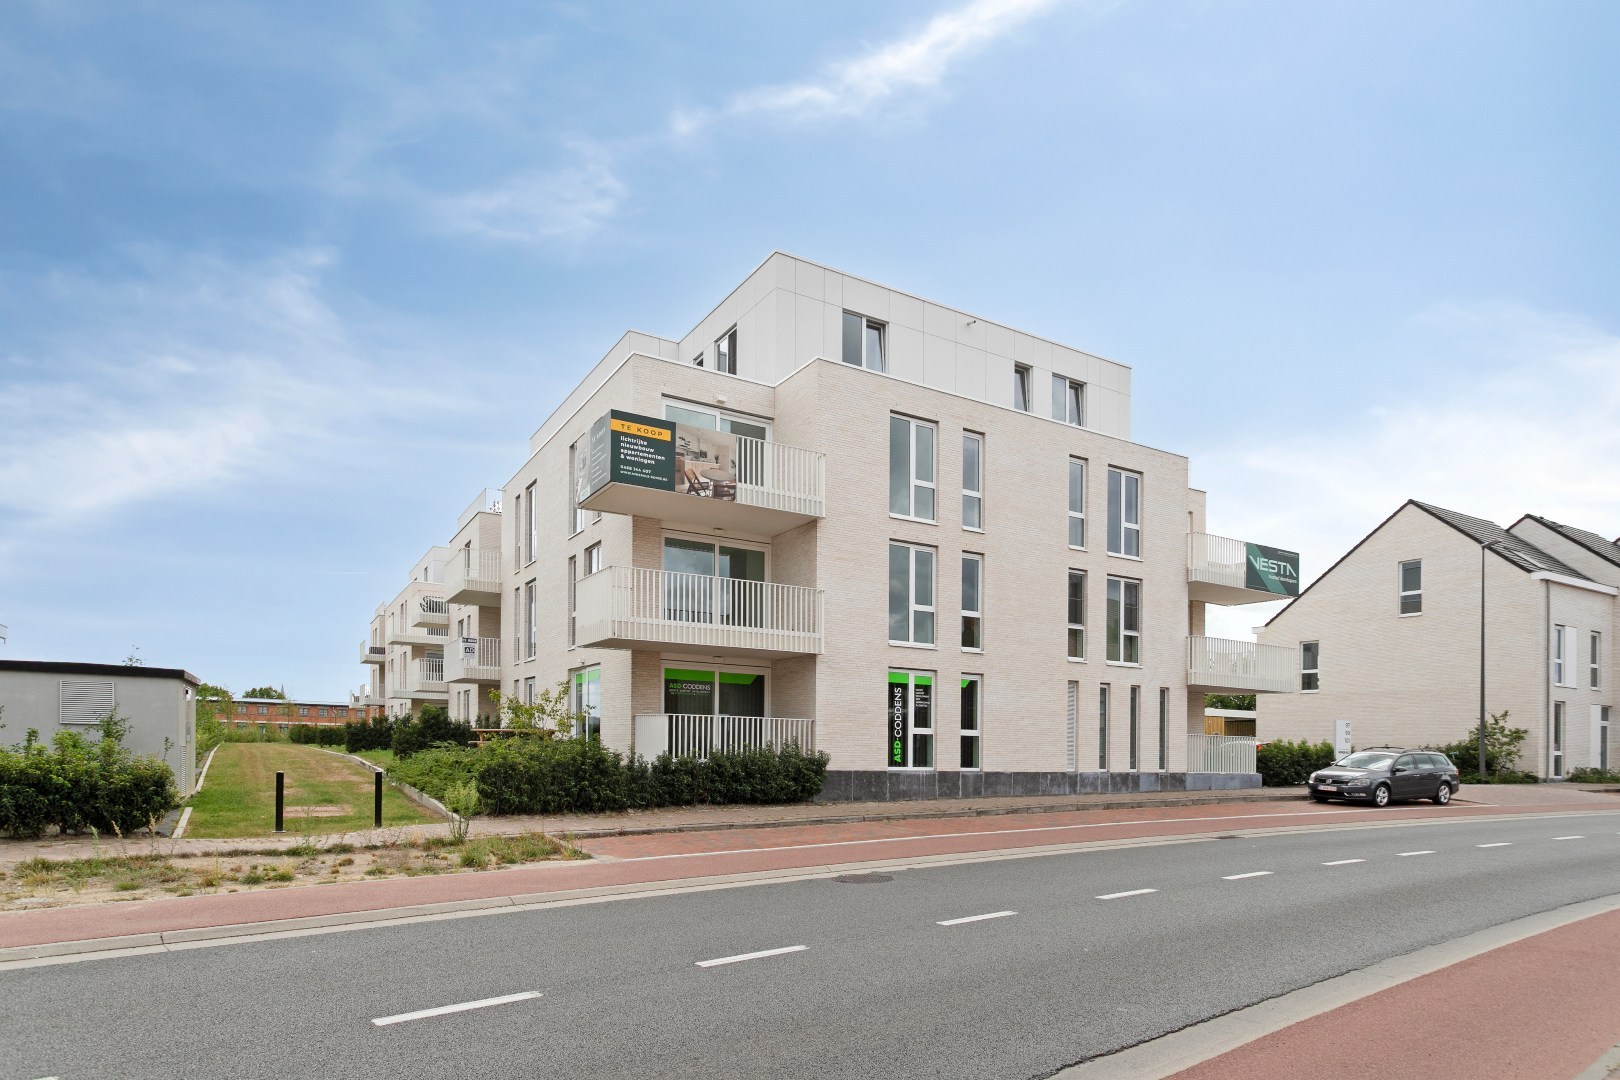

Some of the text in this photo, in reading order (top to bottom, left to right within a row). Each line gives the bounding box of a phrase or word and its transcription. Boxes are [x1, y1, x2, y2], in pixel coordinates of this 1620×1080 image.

[636, 427, 663, 437] KOOP
[620, 435, 648, 446] lichtrijke
[620, 442, 655, 453] nieuwbouw
[620, 448, 666, 461] appartementen
[625, 455, 655, 465] woningen
[1248, 555, 1297, 578] VESTA
[682, 683, 711, 691] CODDENS
[893, 687, 902, 738] CODDENS
